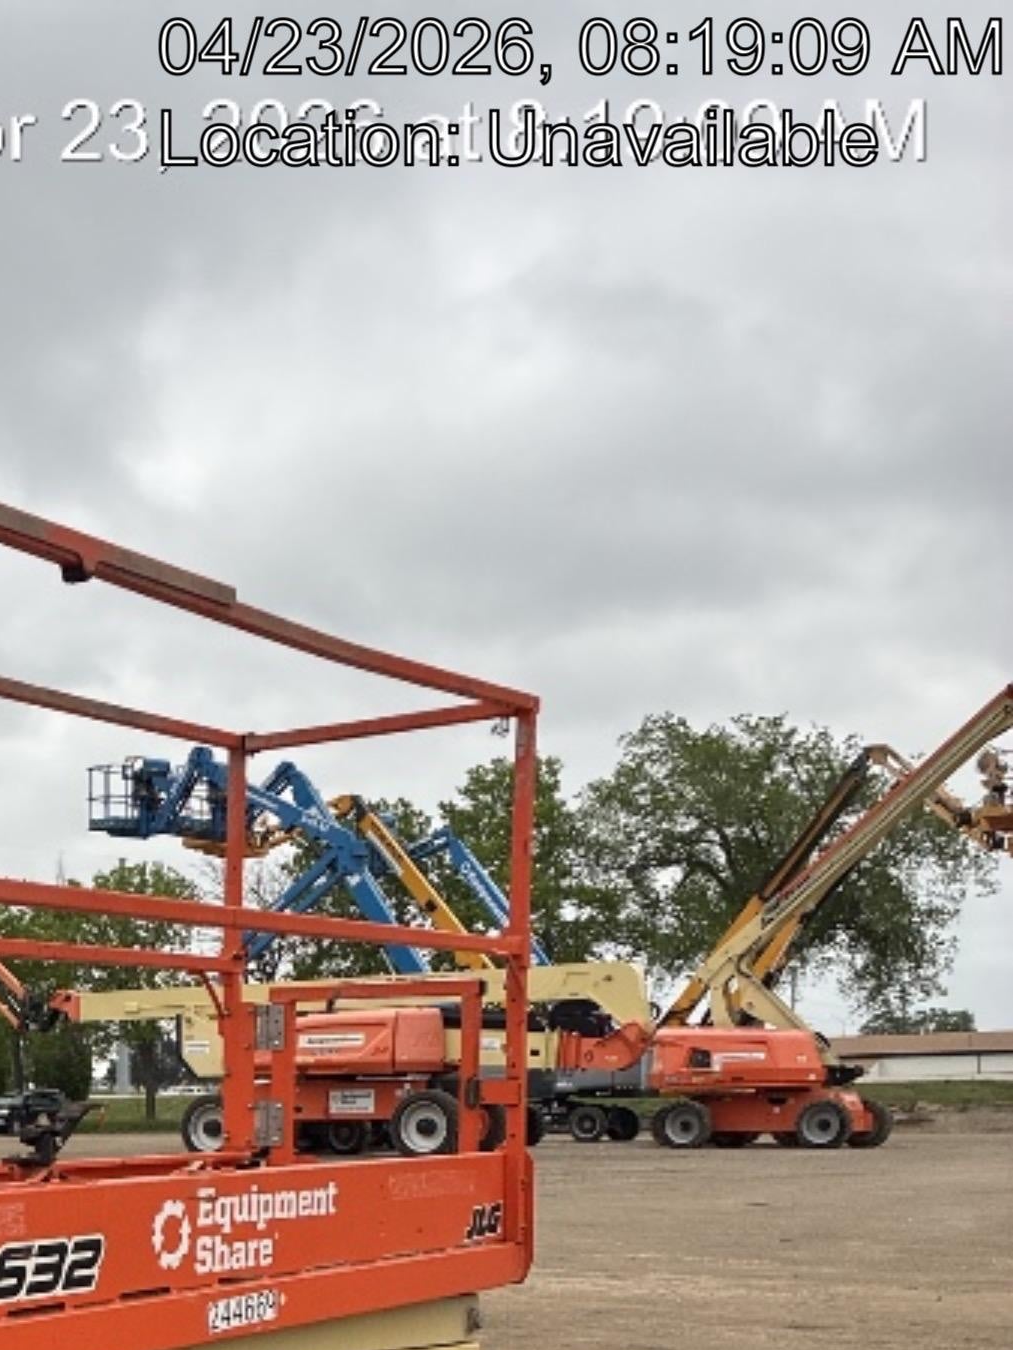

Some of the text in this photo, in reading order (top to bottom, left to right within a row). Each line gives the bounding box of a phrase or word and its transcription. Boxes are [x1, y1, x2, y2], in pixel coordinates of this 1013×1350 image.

[196, 1181, 339, 1234] Equipment
[464, 1200, 503, 1243] JLG
[194, 1235, 274, 1275] Share
